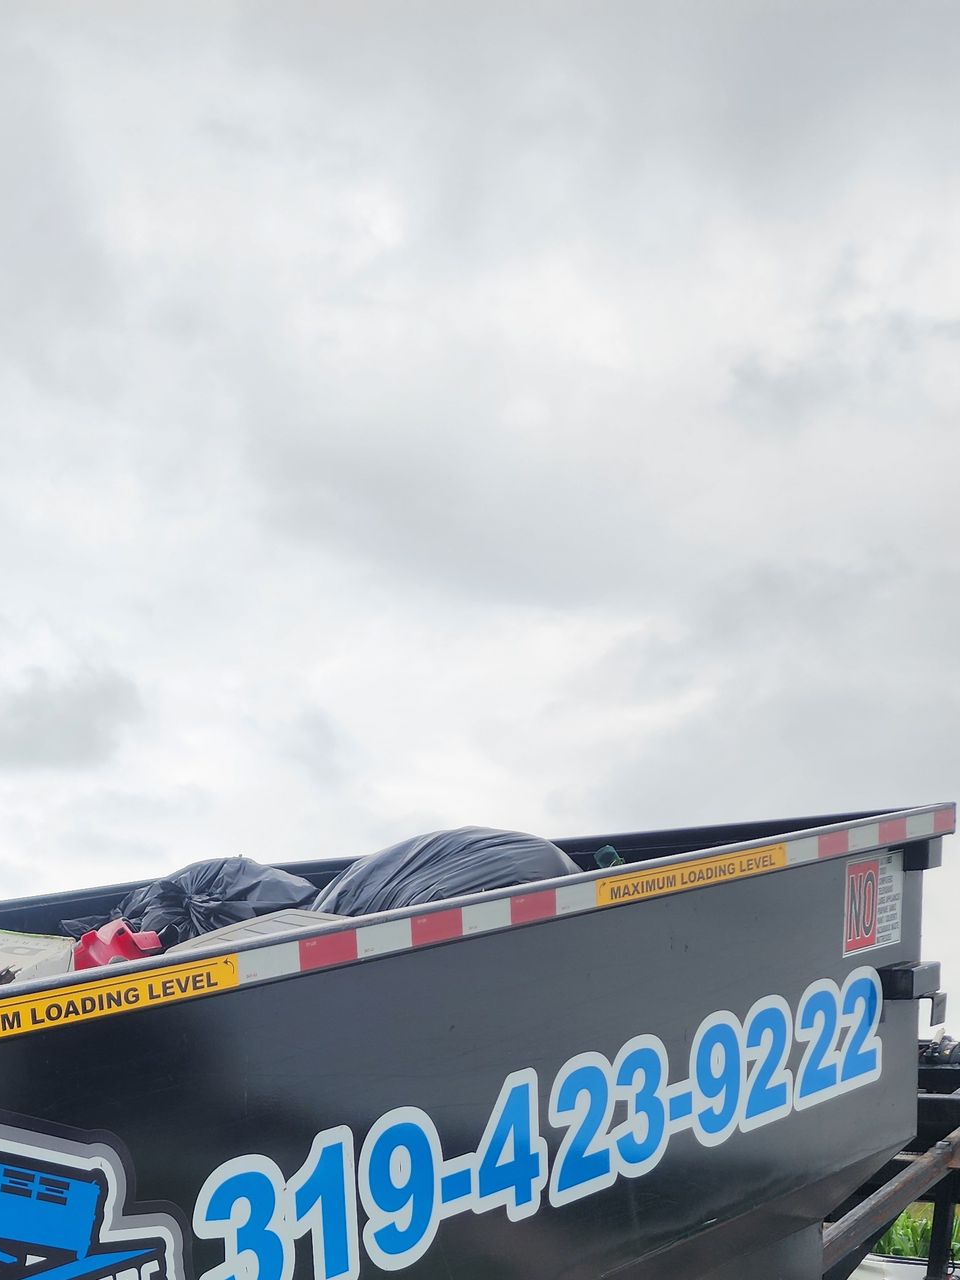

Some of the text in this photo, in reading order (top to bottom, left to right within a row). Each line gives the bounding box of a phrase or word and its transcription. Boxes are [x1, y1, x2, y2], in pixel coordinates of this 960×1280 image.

[609, 853, 776, 900] MAXIMUM LOADING LEVEL
[847, 869, 876, 942] NO
[30, 986, 141, 1025] LOADING
[147, 970, 219, 1000] LEVEL
